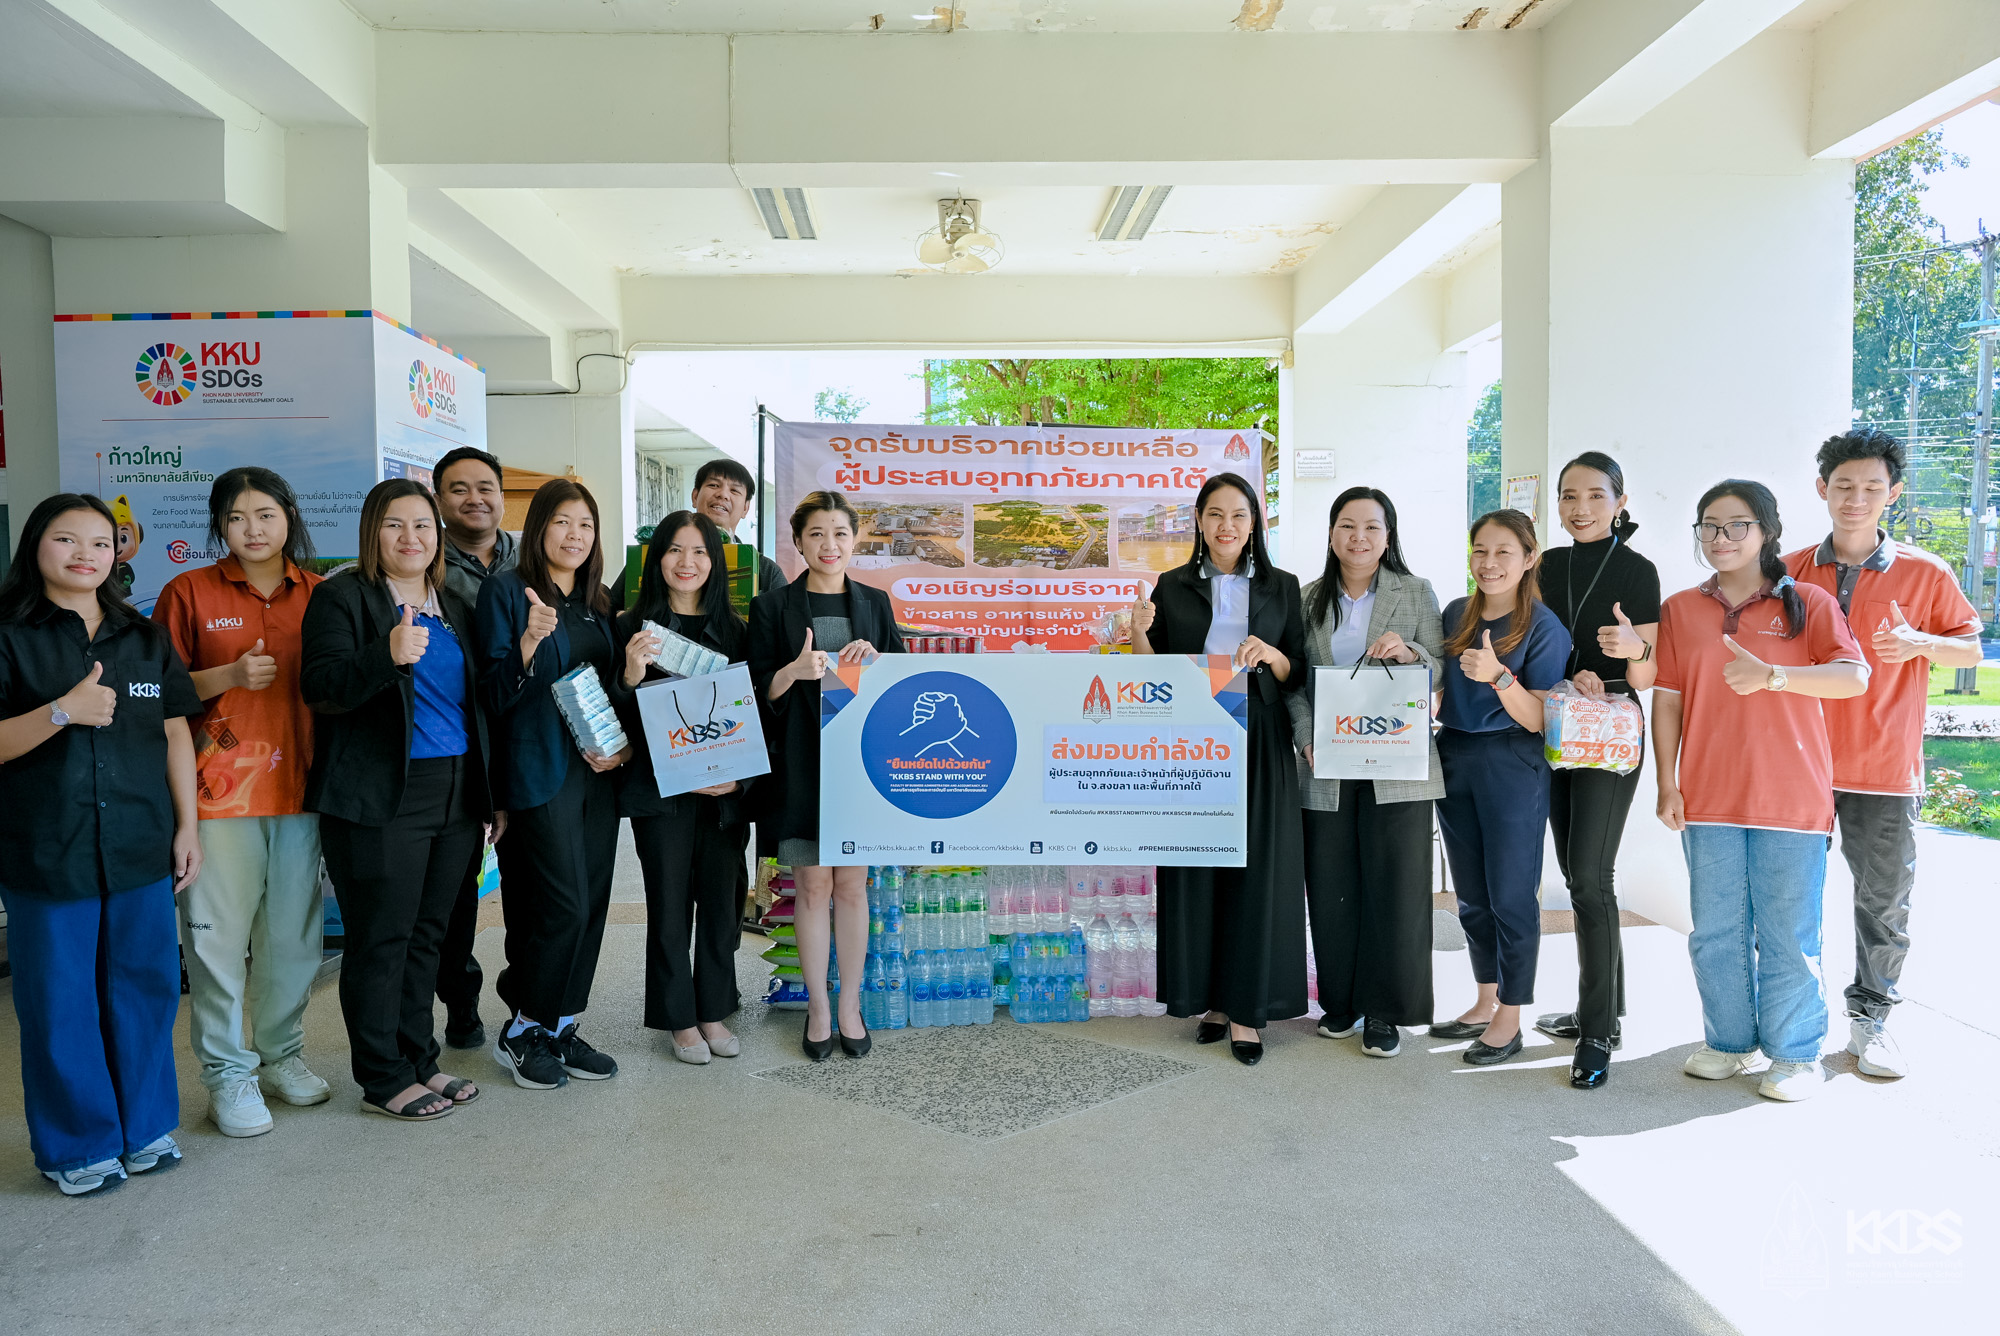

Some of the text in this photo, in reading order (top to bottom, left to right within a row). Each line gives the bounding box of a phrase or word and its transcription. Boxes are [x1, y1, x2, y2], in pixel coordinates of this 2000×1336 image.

[201, 341, 260, 366] KKU
[202, 369, 263, 388] SDGs
[434, 366, 456, 396] KKU
[434, 392, 457, 415] SDGs
[828, 432, 1199, 459] จุดรับบริจาคช่วยเหลือ
[108, 445, 182, 468] ก้าวใหญ่
[116, 470, 214, 483] มหาวิทยาลัยสีเขียว
[835, 462, 1208, 493] ผู้ประสบอุทกภัยภาคใต้
[905, 579, 1139, 597] ขอเชิญร่วมบริจาค
[215, 617, 243, 628] KKU
[903, 607, 978, 620] ข้าวสาร
[985, 608, 1085, 620] อาหารแห้ง
[129, 682, 160, 698] KKBS
[1117, 682, 1172, 704] KKBS
[668, 720, 721, 750] KKBS
[1336, 716, 1387, 736] KKBS
[1051, 736, 1231, 761] ส่งมอบกำลังใจ
[1607, 744, 1631, 759] 79
[1050, 767, 1231, 780] ผู้ประสบอุทกภัยและเจ้าหน้าที่ผู้ปฏิบัติงาน
[1078, 781, 1088, 790] ใน
[1133, 779, 1202, 790] และพื้นที่ภาคใต้
